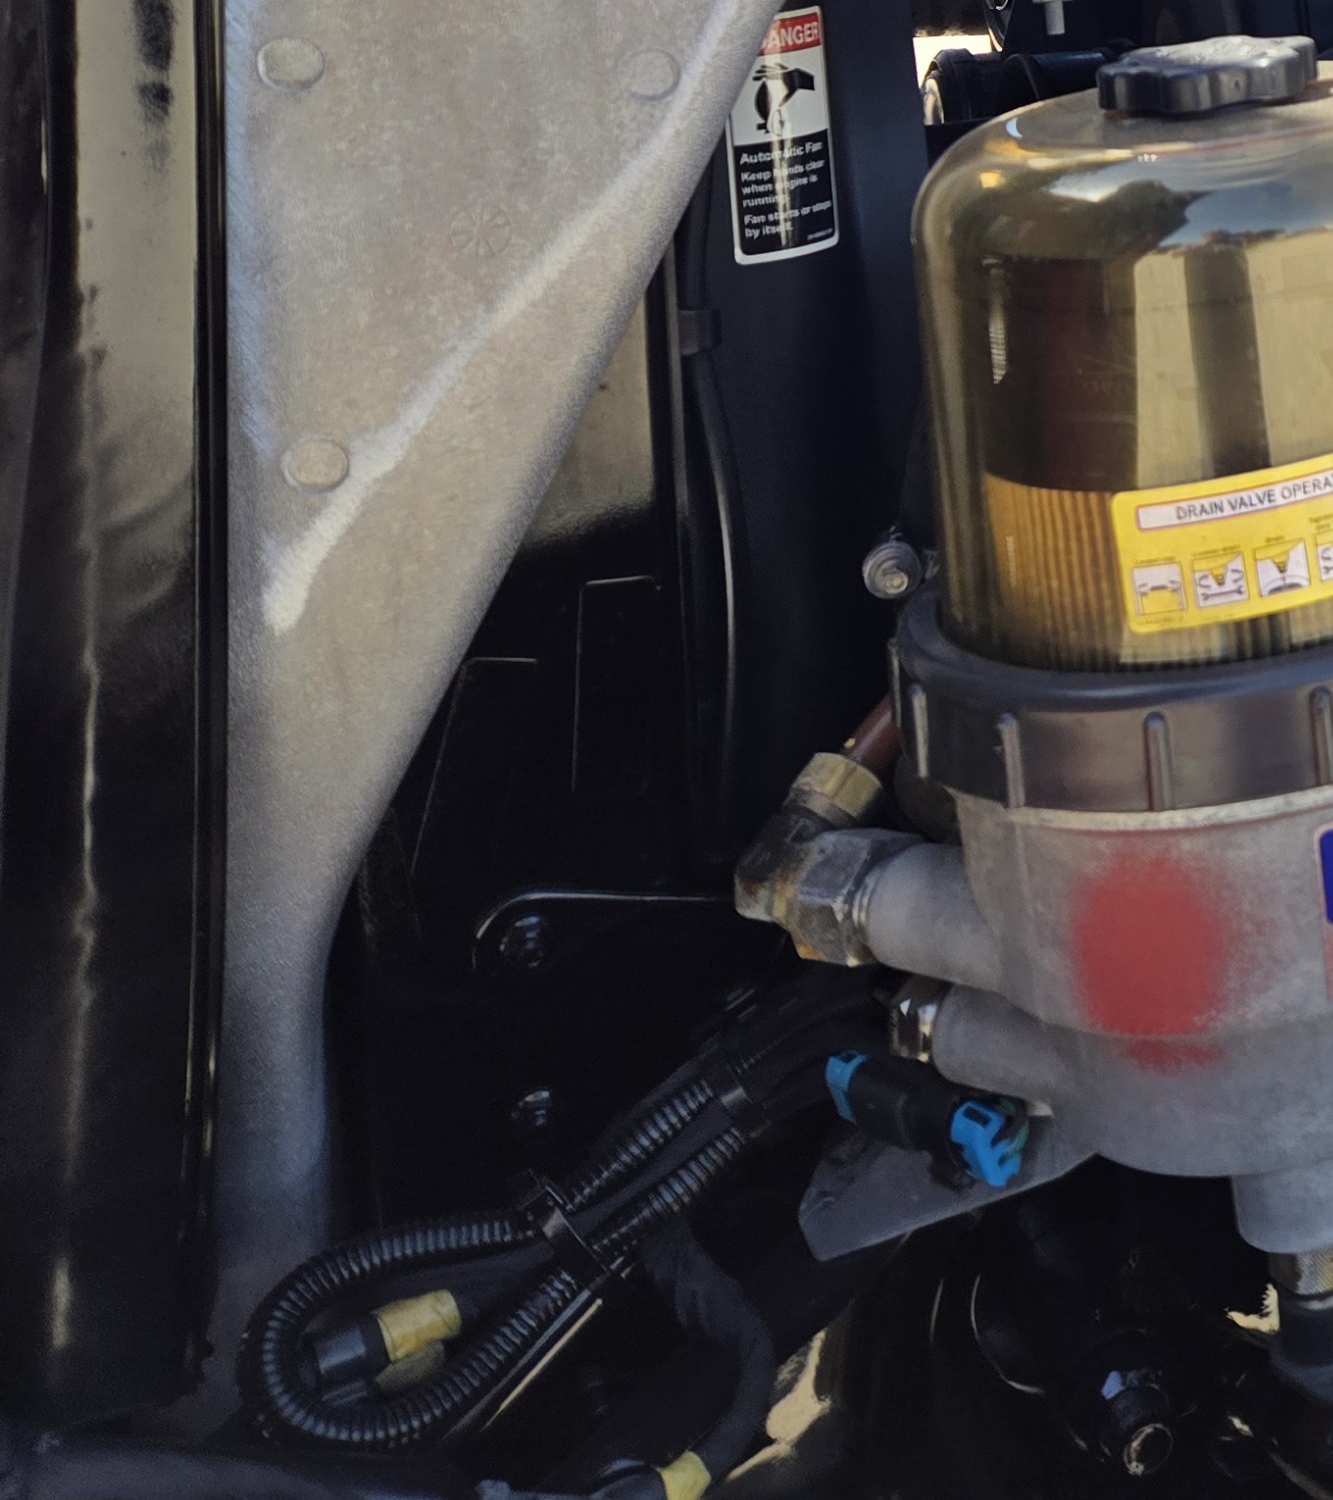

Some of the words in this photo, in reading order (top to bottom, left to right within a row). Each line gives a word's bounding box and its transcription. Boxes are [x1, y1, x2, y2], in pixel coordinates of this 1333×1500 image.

[740, 146, 805, 165] Automatic
[740, 170, 772, 182] Keep
[743, 214, 767, 225] Fan
[744, 228, 761, 240] by
[1175, 500, 1225, 521] DRAIN
[1228, 490, 1277, 511] VALVE
